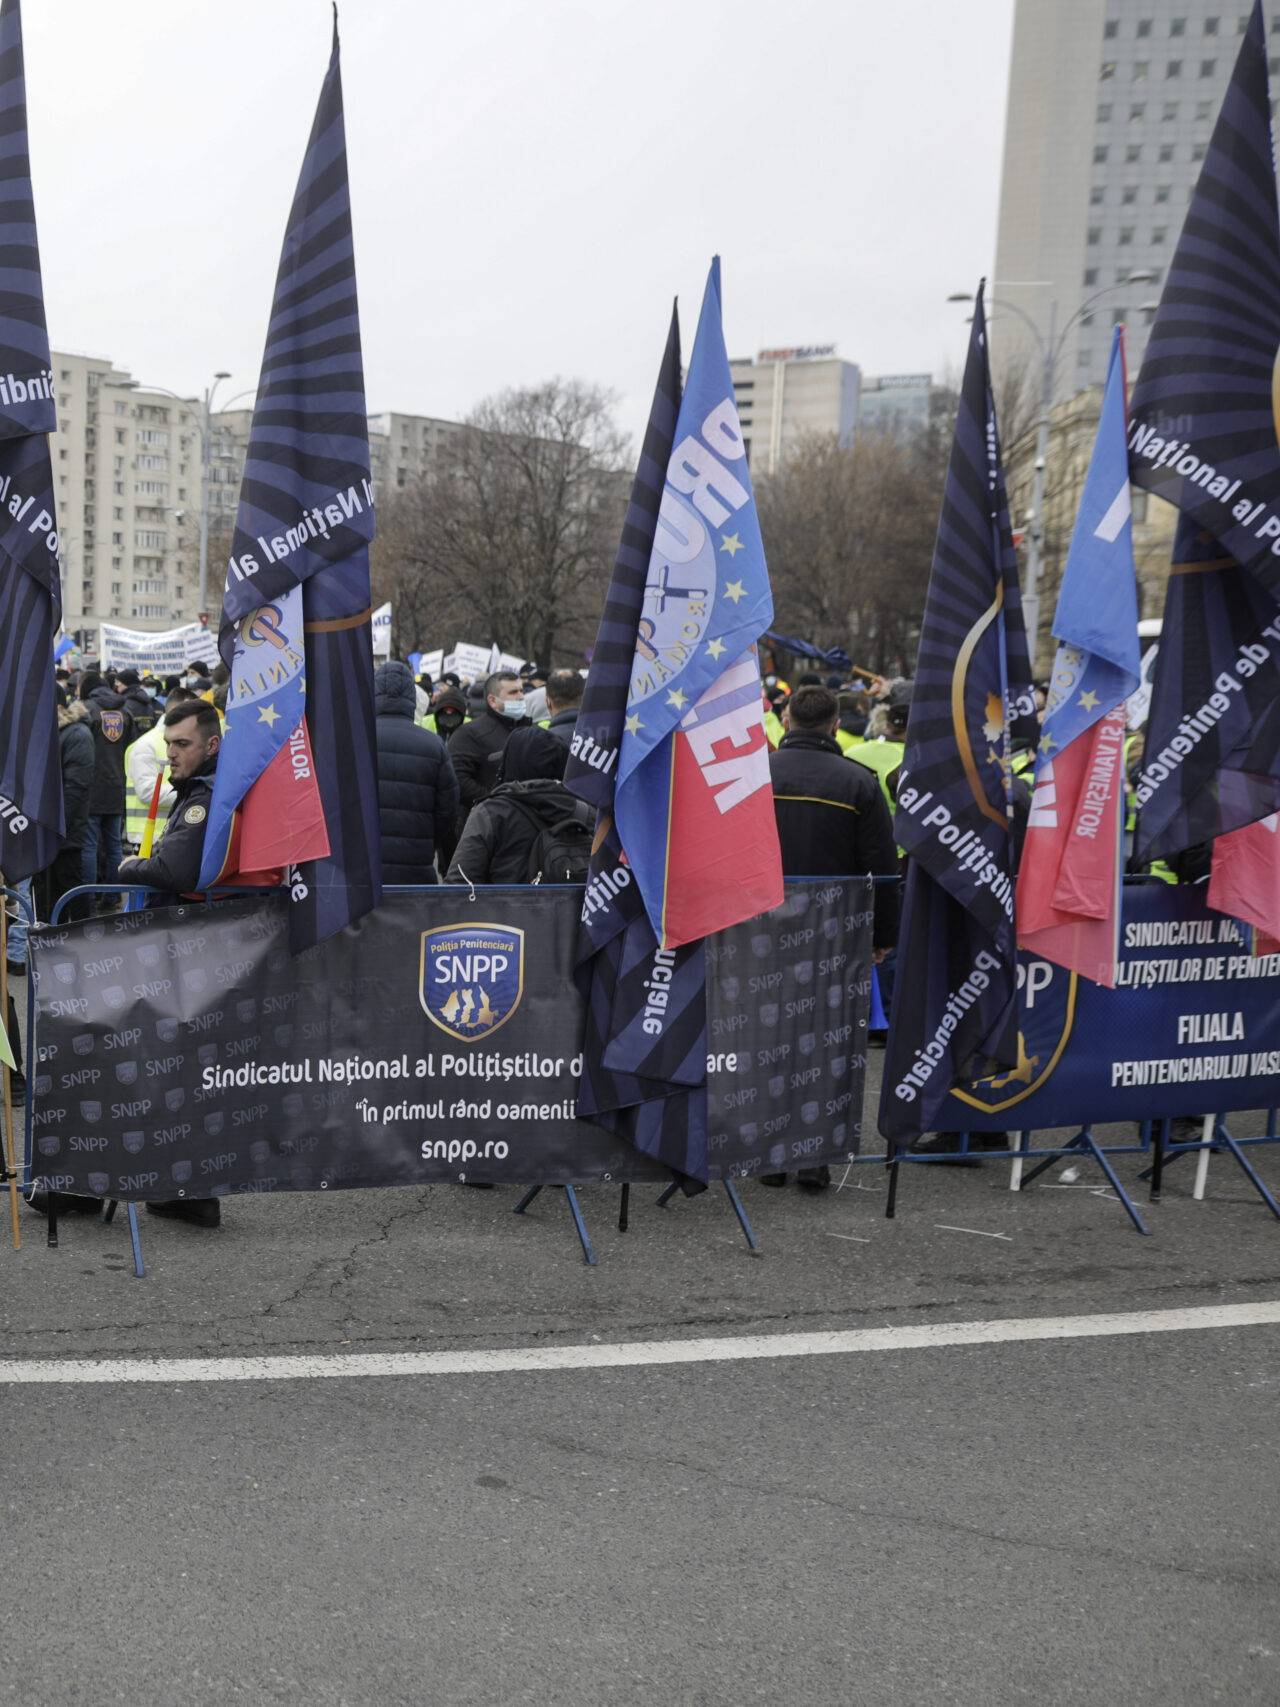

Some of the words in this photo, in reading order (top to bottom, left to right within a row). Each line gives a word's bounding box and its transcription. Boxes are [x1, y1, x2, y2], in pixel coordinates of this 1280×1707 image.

[1232, 493, 1253, 527] al
[780, 929, 814, 949] SNPP
[1124, 920, 1215, 948] SINDICATUL
[1217, 918, 1244, 947] NA
[430, 940, 458, 953] Poliția
[84, 957, 123, 977] SNPP
[435, 955, 509, 983] SNPP
[1210, 956, 1224, 980] DE
[132, 980, 171, 1001] SNPP
[749, 972, 783, 994] SNPP
[50, 998, 88, 1017] SNPP
[104, 1028, 142, 1050] SNPP
[1177, 1011, 1245, 1045] FILIALA
[146, 1055, 184, 1076] SNPP
[202, 1059, 313, 1090] Sindicatul
[318, 1055, 410, 1085] Național
[415, 1054, 435, 1078] al
[441, 1052, 565, 1081] Polițiștilor
[1111, 1054, 1248, 1088] PENITENCIARULUI
[61, 1069, 101, 1089] SNPP
[111, 1100, 151, 1119] SNPP
[383, 1099, 445, 1125] primul
[449, 1098, 492, 1119] rând
[70, 1137, 108, 1151] SNPP
[421, 1139, 509, 1163] snpp.ro
[119, 1172, 159, 1191] SNPP
